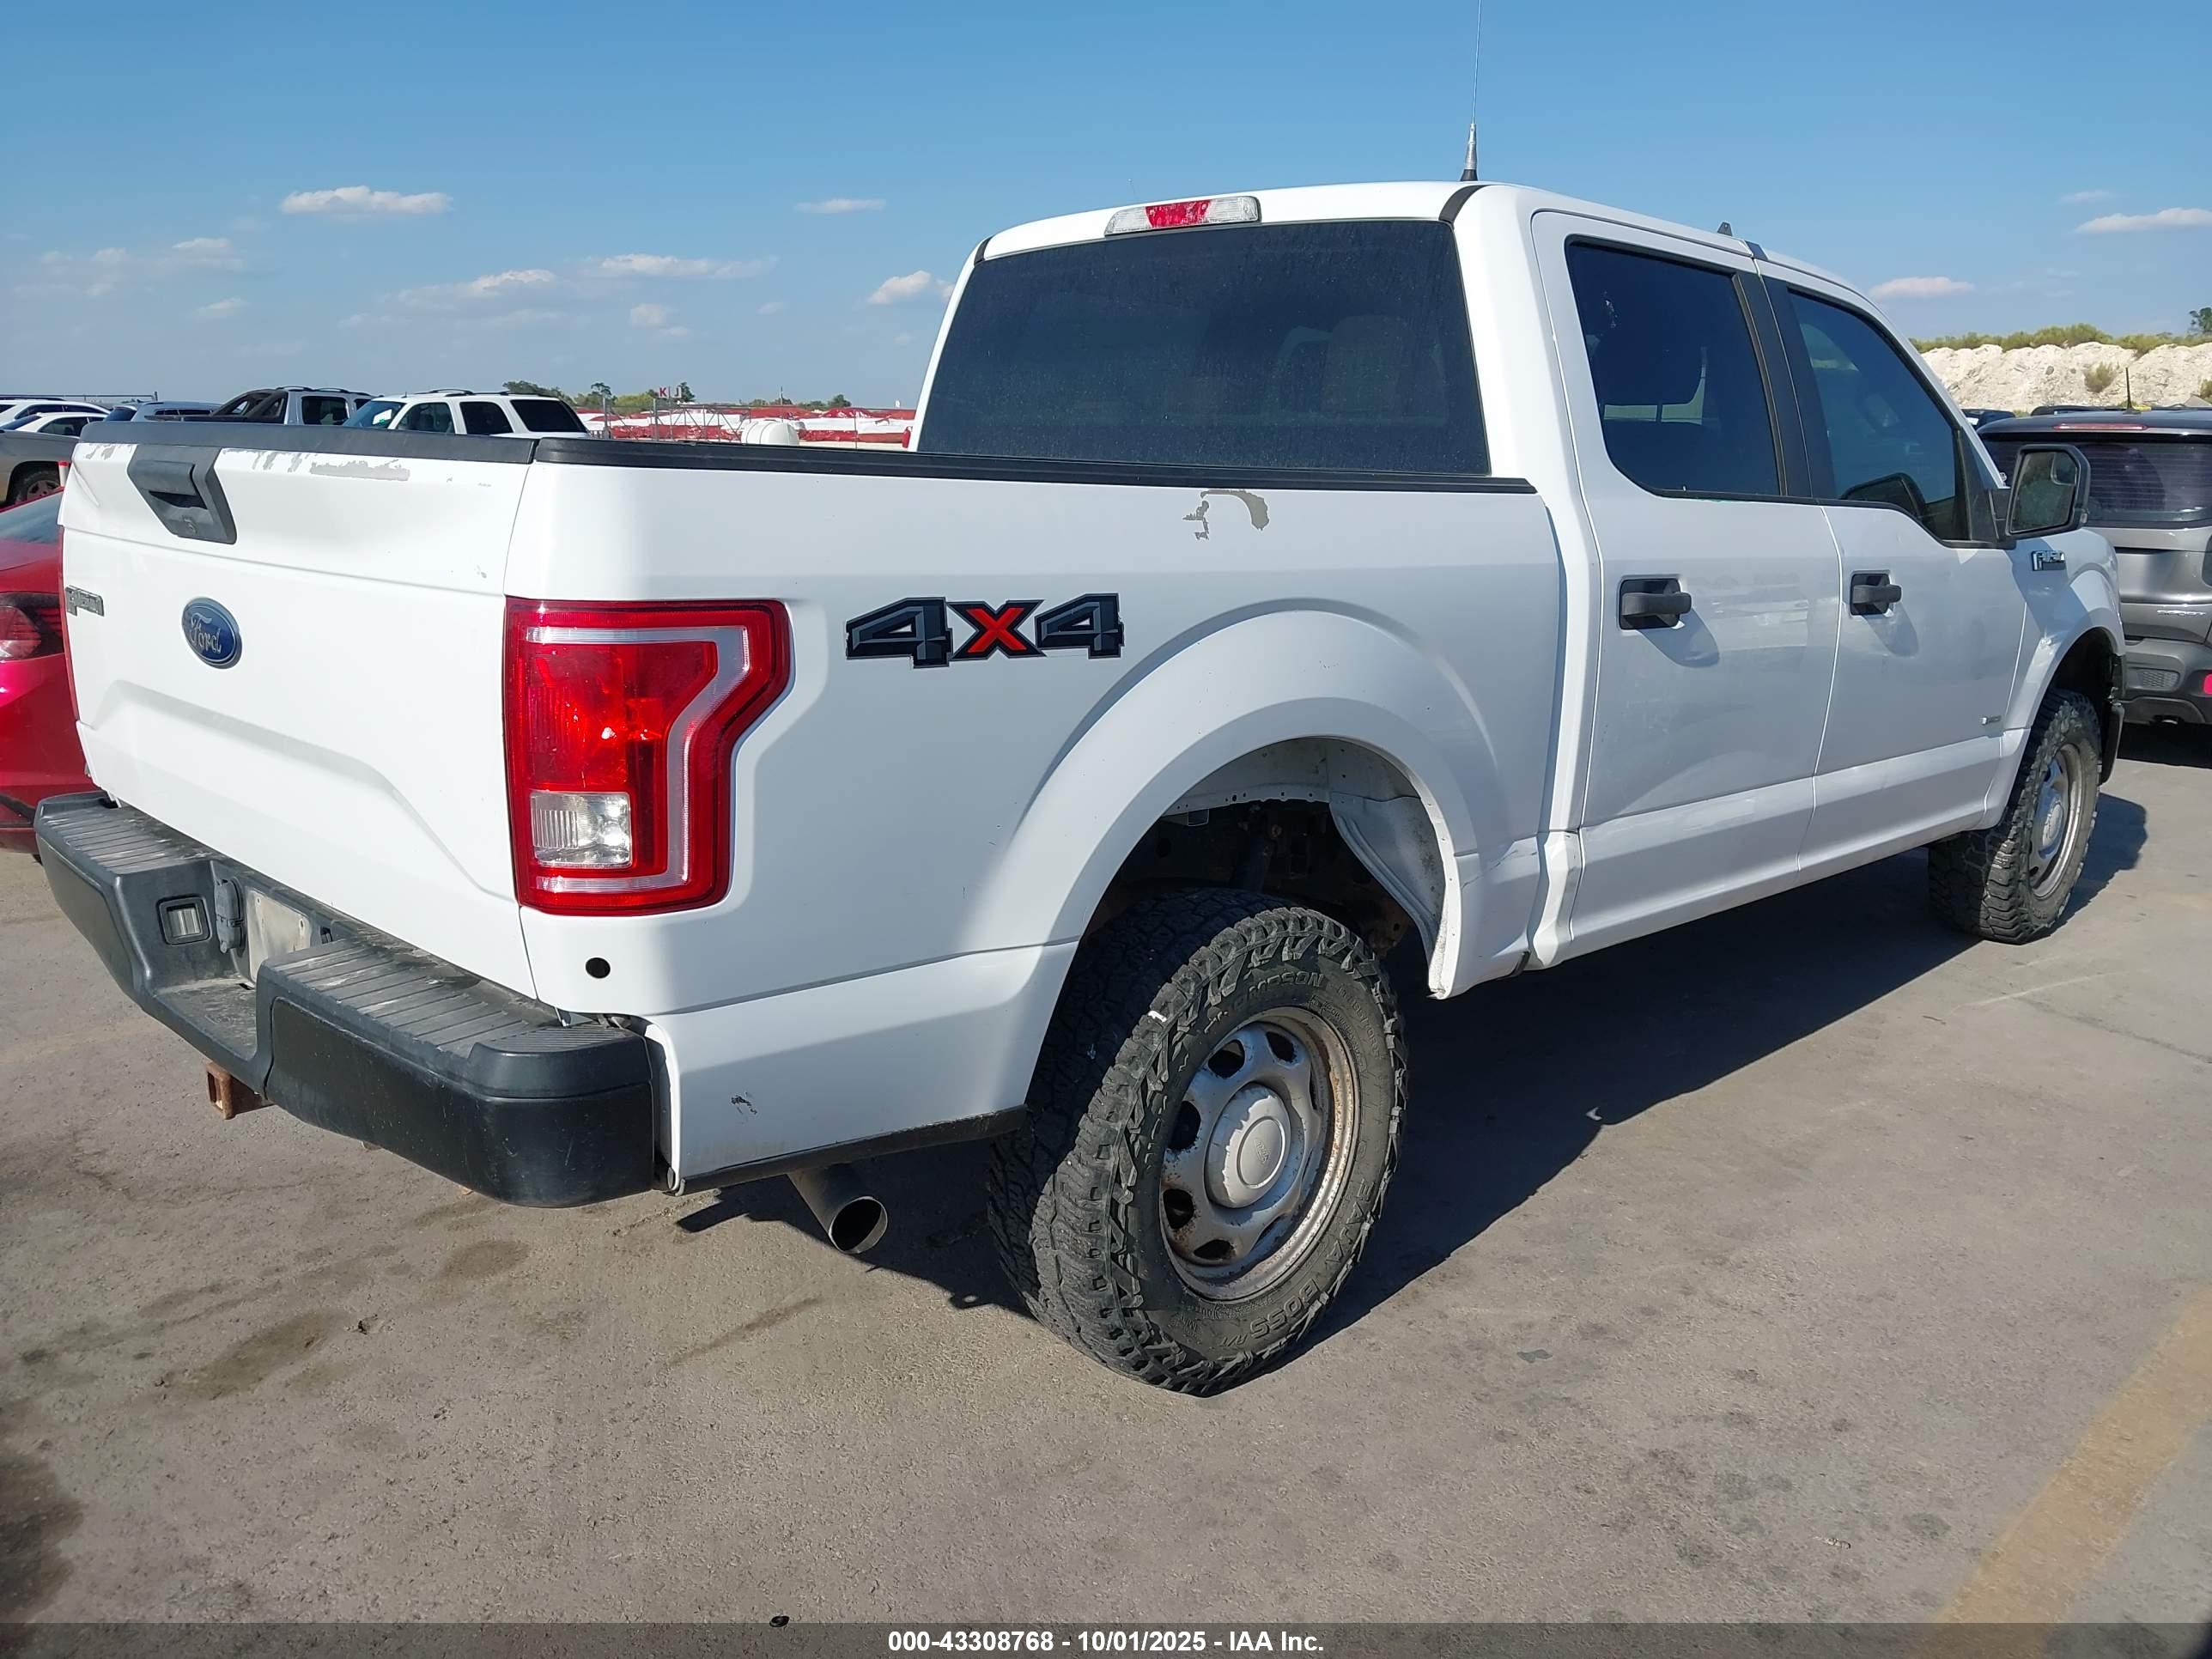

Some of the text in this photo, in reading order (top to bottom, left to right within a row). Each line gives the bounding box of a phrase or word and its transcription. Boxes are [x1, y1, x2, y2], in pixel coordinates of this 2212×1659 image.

[659, 387, 667, 398] K
[189, 611, 222, 654] Ford
[1249, 1278, 1321, 1340] BOSS
